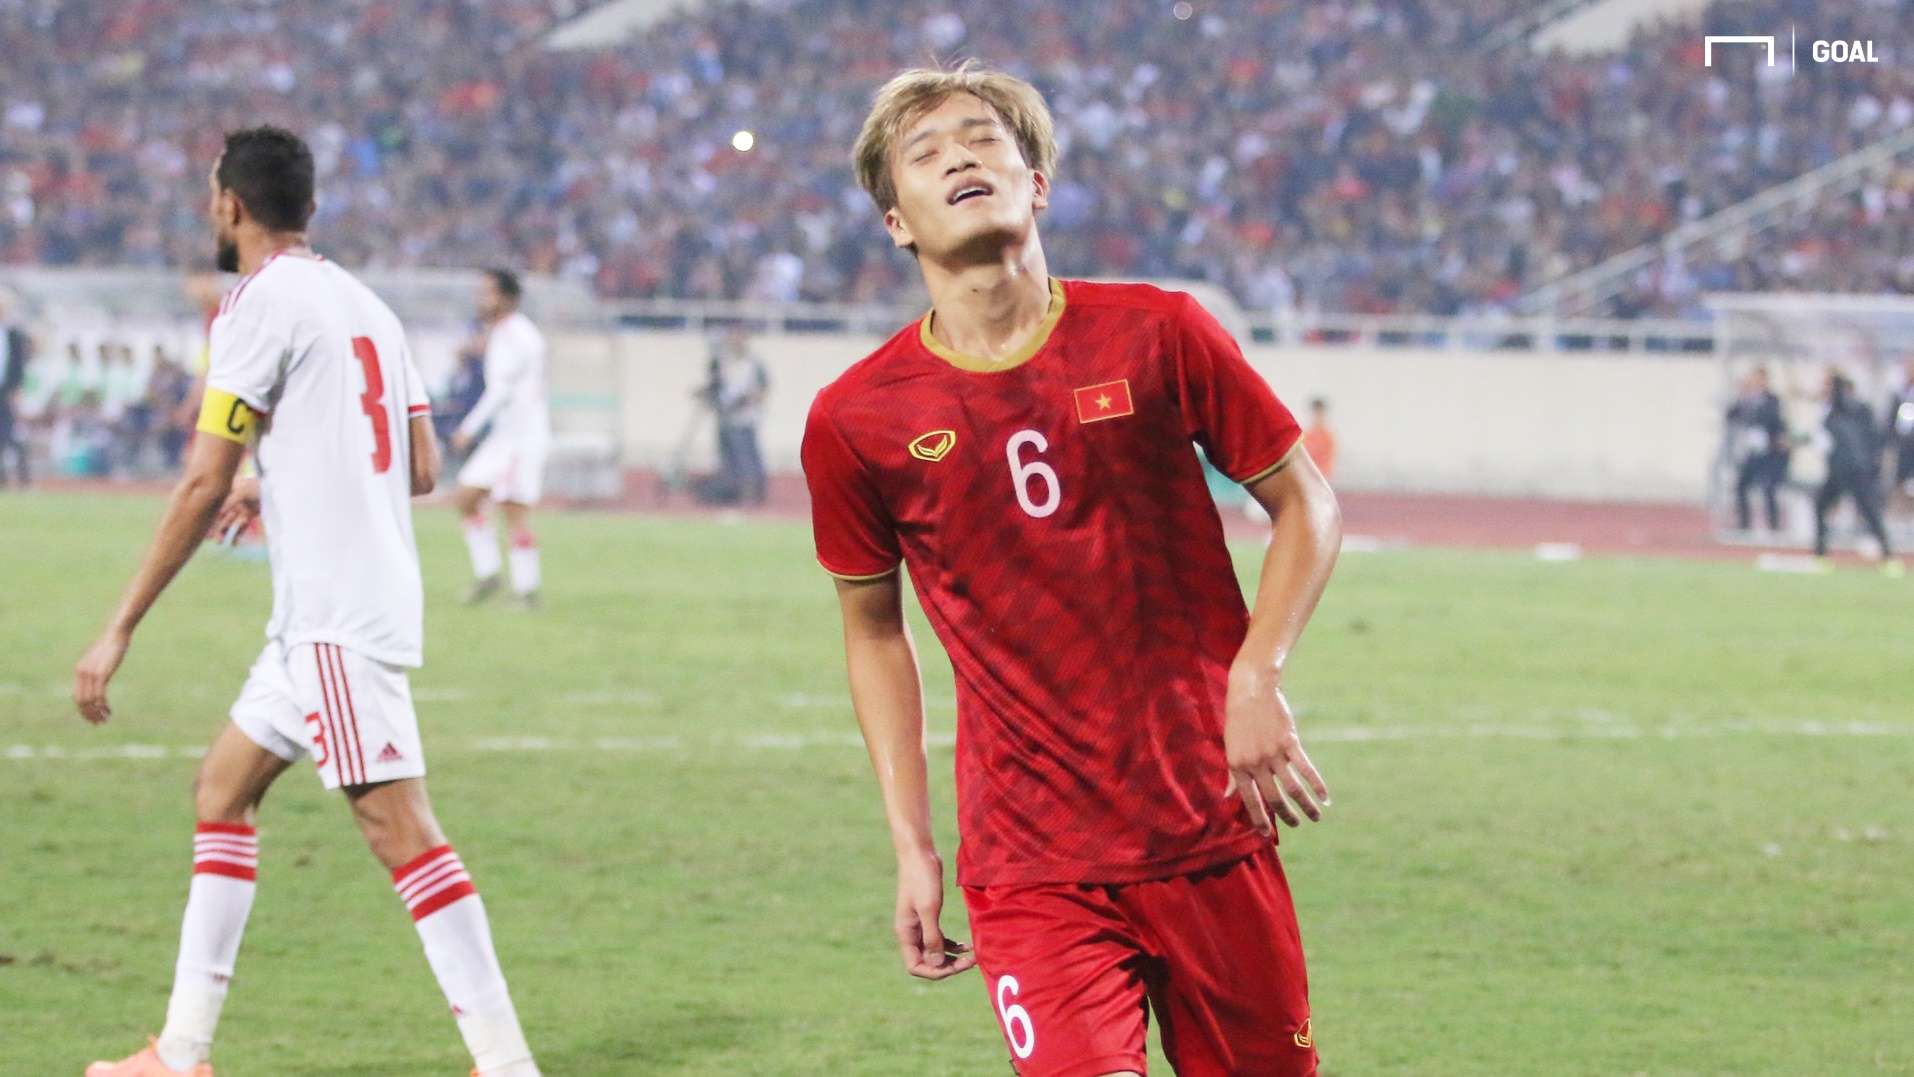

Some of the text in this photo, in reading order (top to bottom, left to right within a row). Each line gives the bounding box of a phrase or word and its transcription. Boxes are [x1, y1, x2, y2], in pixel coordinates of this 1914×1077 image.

[227, 398, 250, 434] C
[351, 335, 393, 474] 3
[1006, 429, 1062, 519] 6
[304, 711, 329, 768] 3
[996, 974, 1035, 1060] 6
